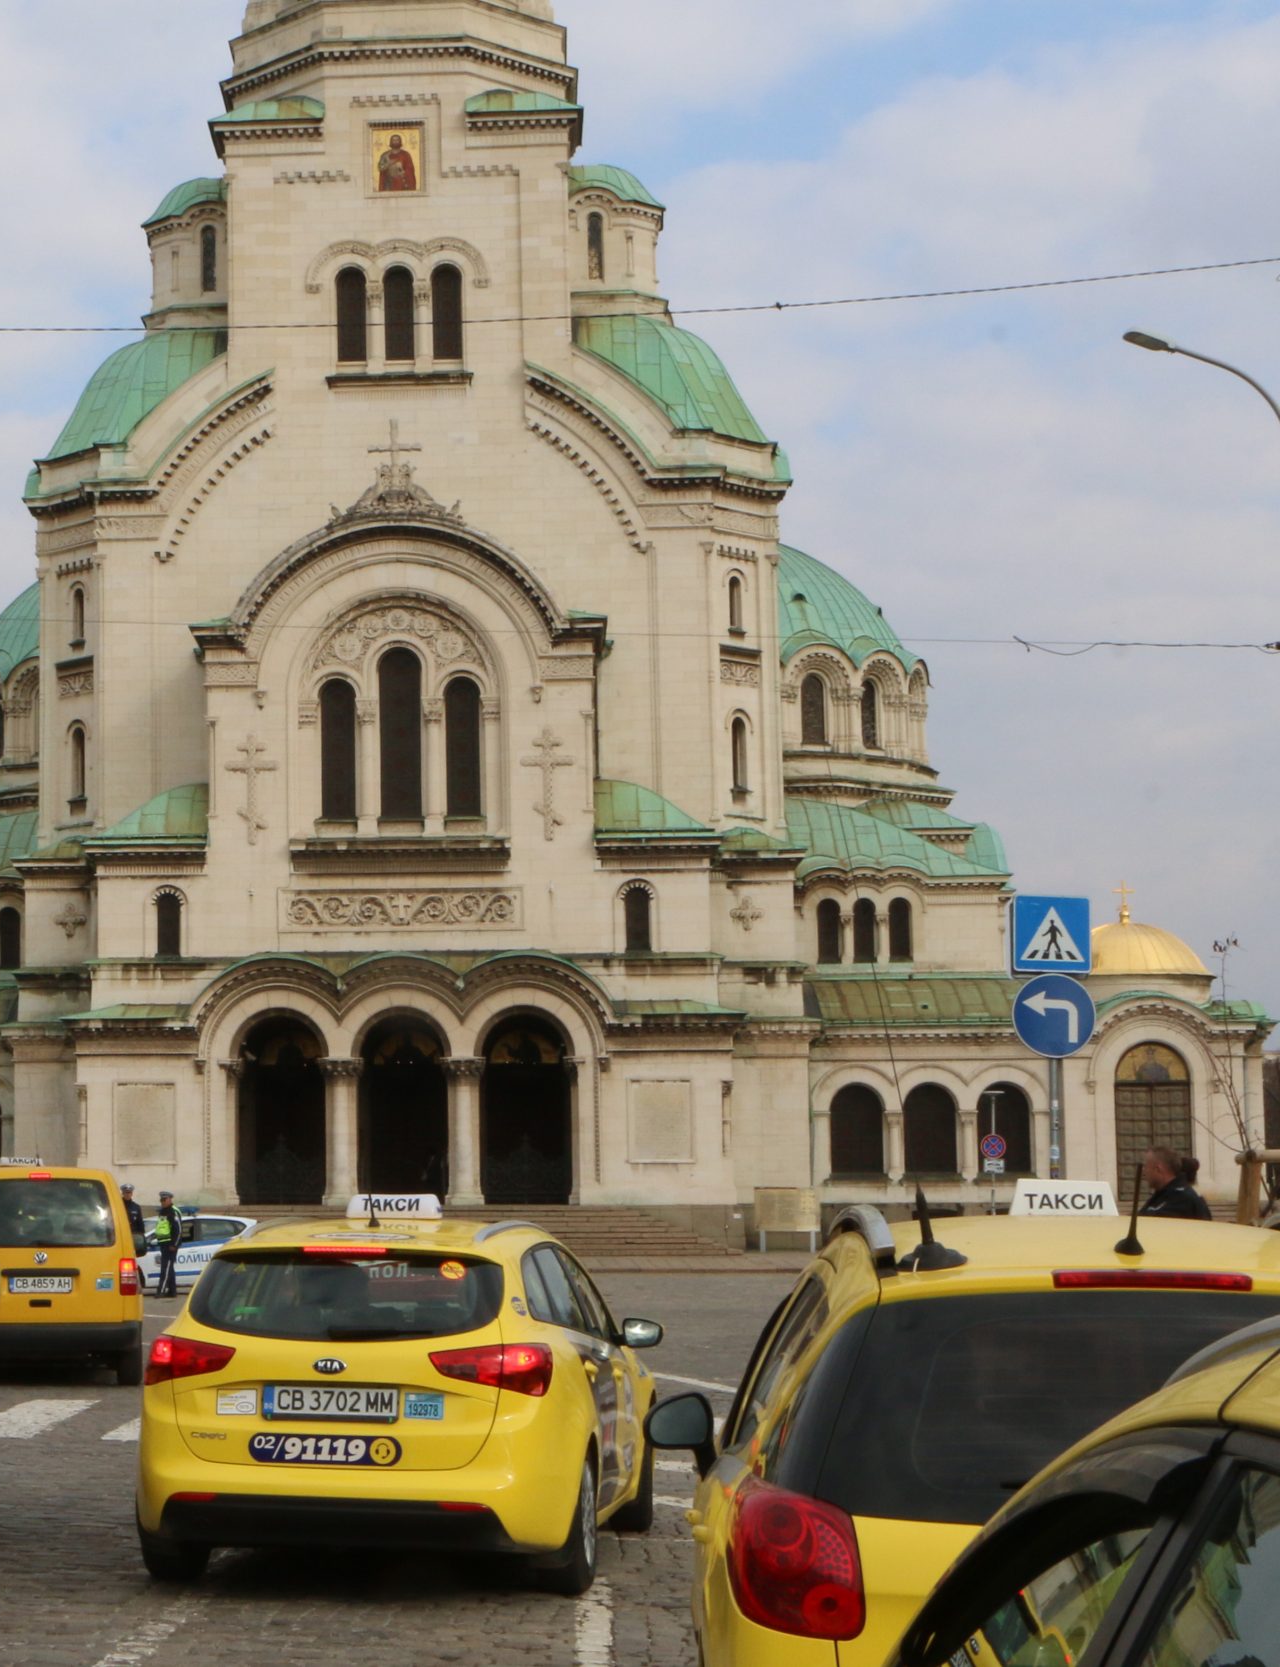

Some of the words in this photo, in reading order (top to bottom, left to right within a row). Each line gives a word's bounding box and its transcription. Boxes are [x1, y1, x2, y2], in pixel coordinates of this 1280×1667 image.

[361, 1198, 421, 1212] ТАКСИ
[1024, 1193, 1103, 1210] ТАКСИ
[32, 1278, 55, 1289] 4859
[316, 1360, 341, 1372] KIA
[276, 1389, 305, 1411] CB
[308, 1390, 361, 1413] 3702
[365, 1391, 394, 1414] MM
[407, 1402, 440, 1418] 192978
